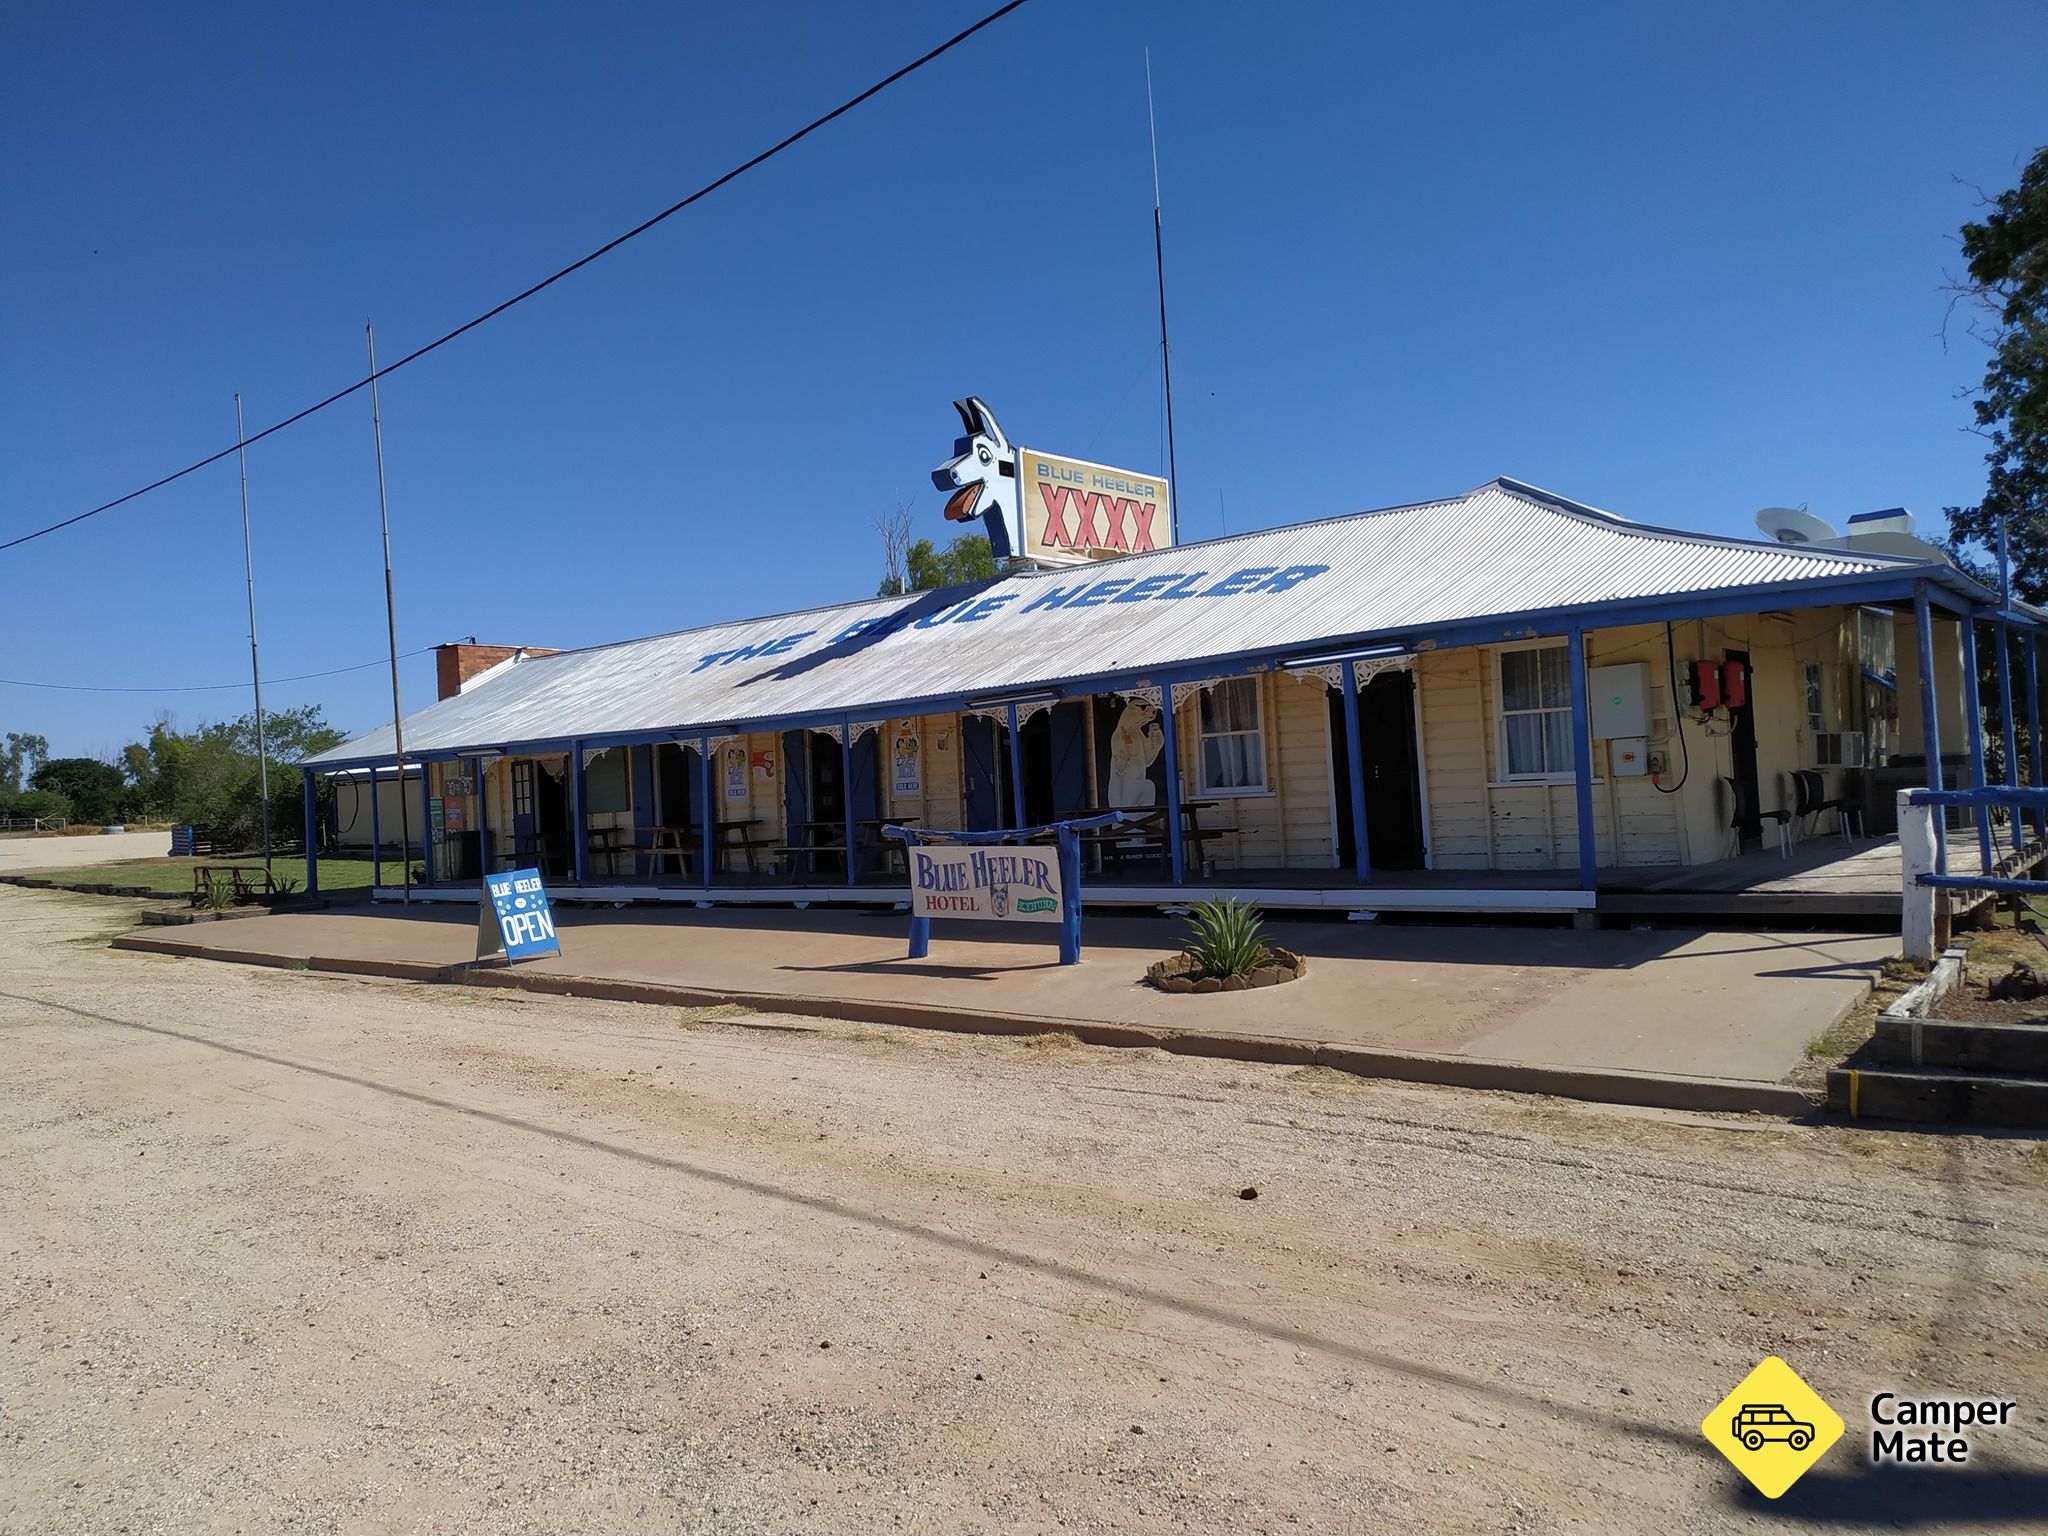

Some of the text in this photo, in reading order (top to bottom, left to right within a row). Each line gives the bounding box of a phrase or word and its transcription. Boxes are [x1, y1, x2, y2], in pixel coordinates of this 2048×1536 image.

[1037, 463, 1155, 498] BLUE HEELER
[1038, 482, 1156, 553] XXXX
[690, 564, 1331, 674] THE BLUE HEELER
[491, 877, 542, 898] BLUE HEELER
[915, 850, 1058, 894] BLUE HEELER
[925, 895, 980, 911] HOTEL
[501, 909, 555, 946] OPEN
